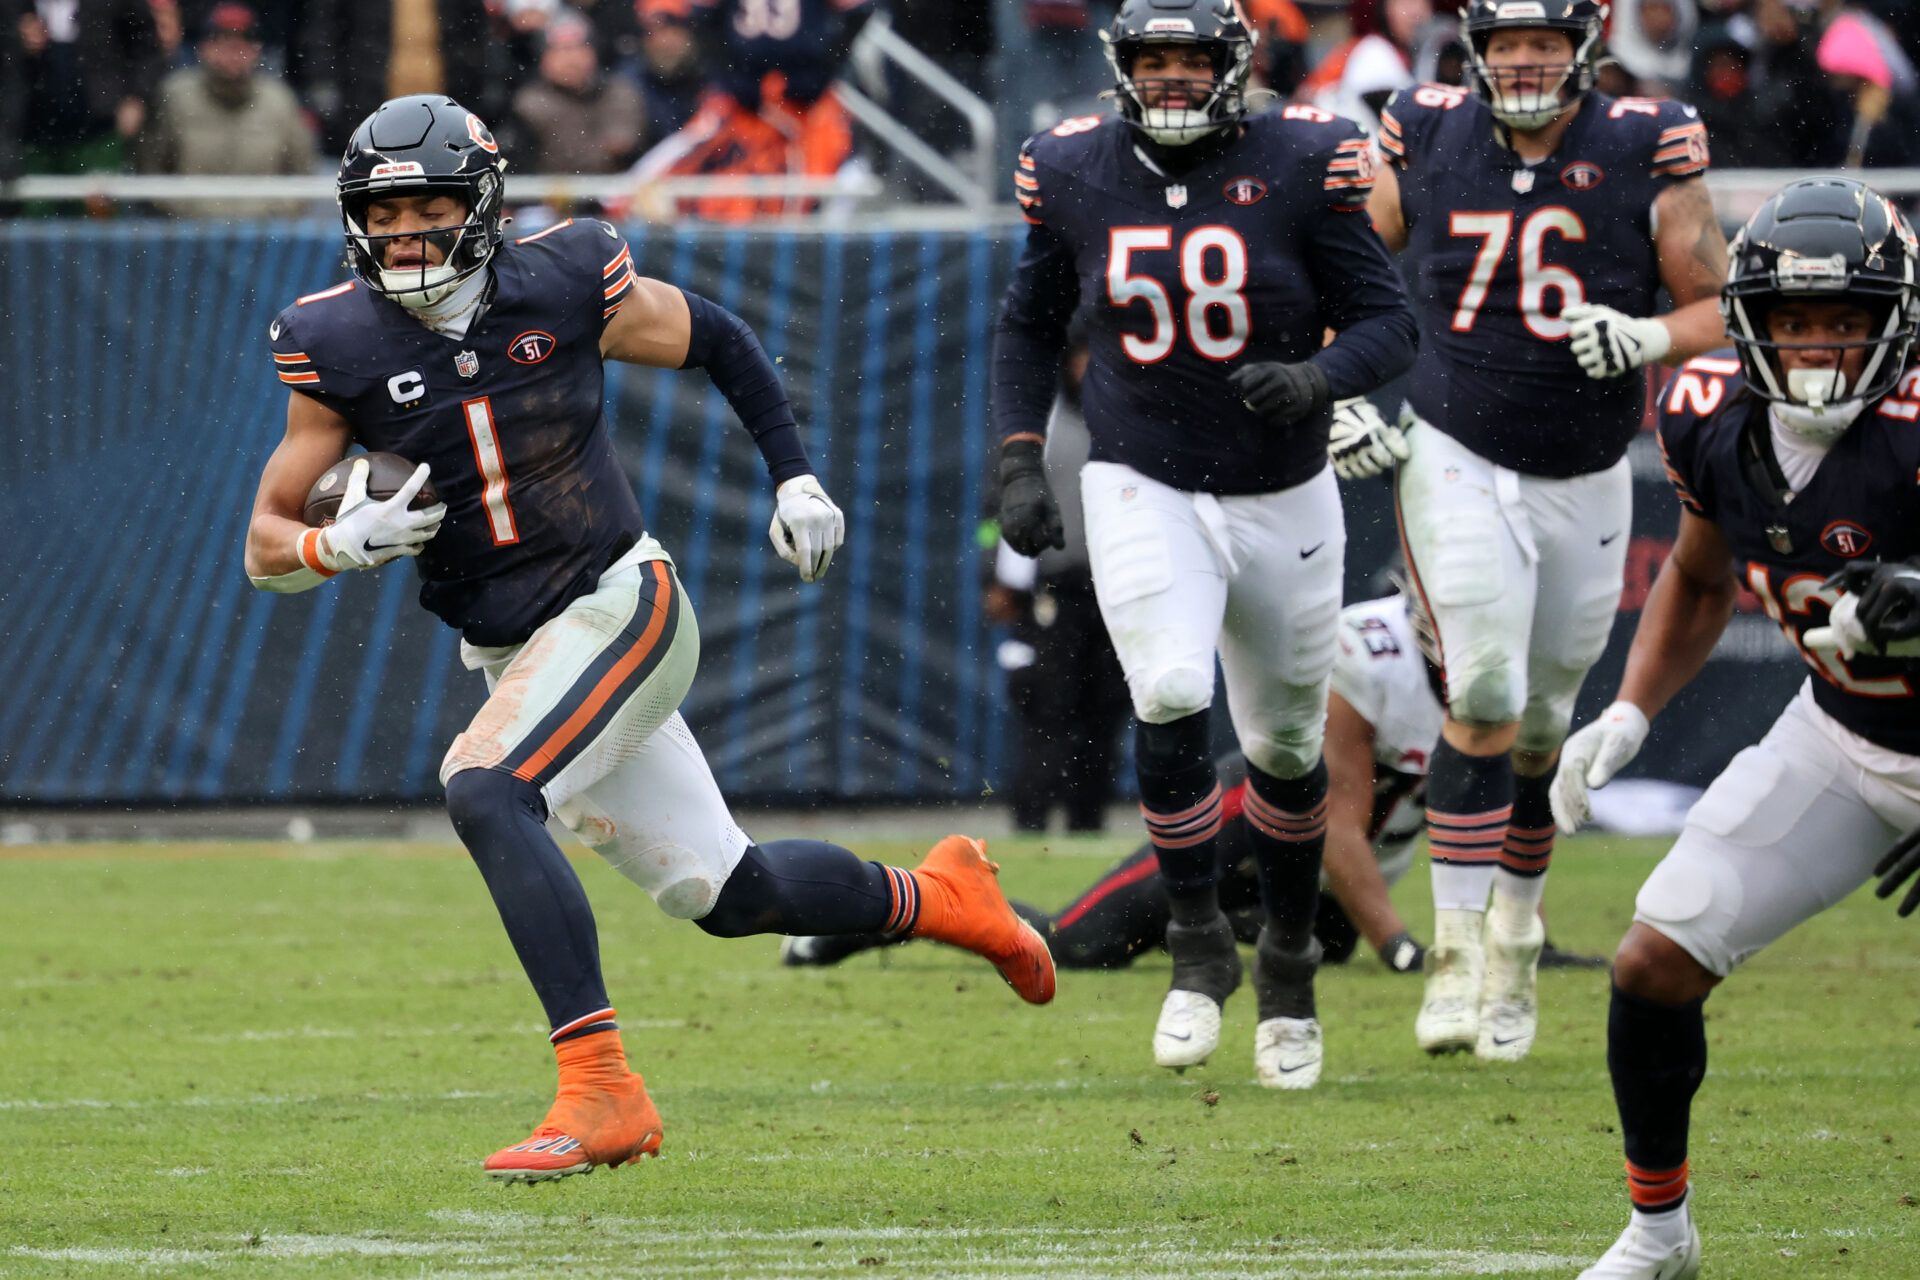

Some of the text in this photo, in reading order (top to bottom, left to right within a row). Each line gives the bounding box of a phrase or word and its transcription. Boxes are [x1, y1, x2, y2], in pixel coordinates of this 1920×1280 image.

[376, 164, 415, 175] BEARS
[1450, 206, 1586, 341] 76
[1106, 224, 1253, 364] 58
[522, 341, 541, 361] 51
[460, 361, 477, 375] NFL
[387, 370, 426, 404] C
[461, 395, 520, 546] 1
[1836, 533, 1856, 554] 51
